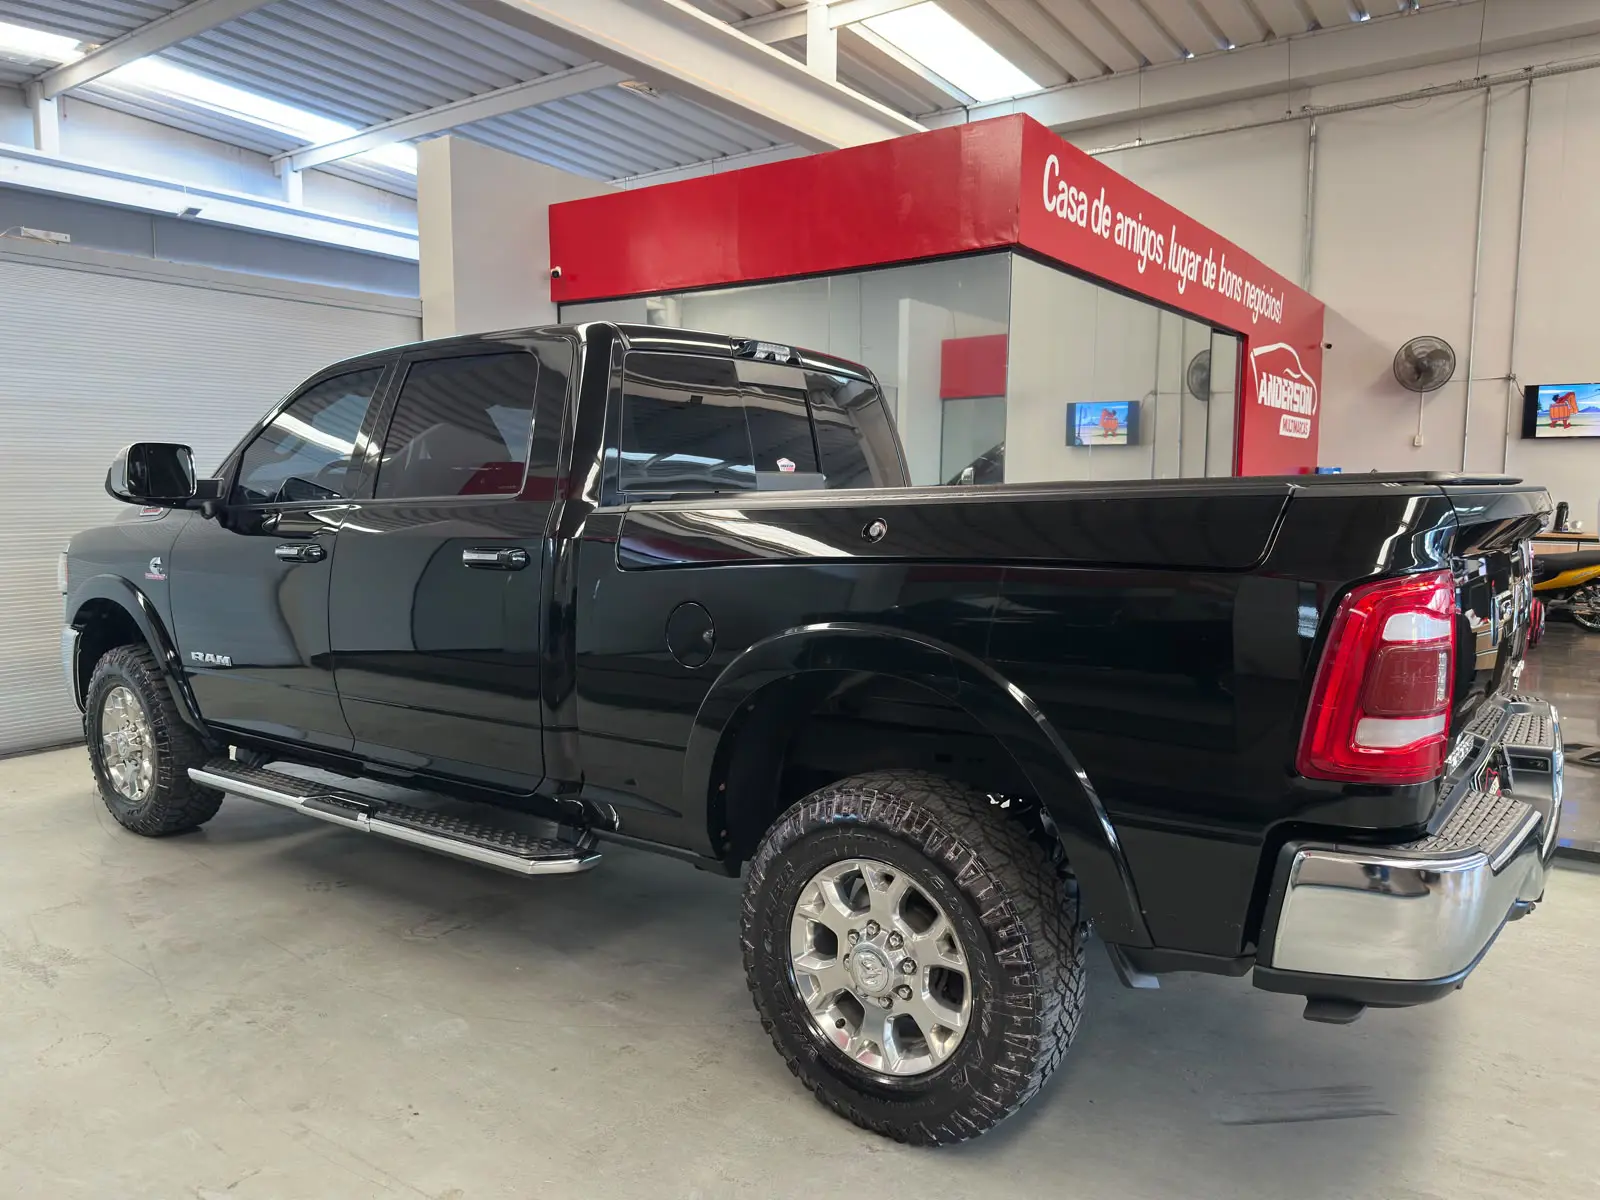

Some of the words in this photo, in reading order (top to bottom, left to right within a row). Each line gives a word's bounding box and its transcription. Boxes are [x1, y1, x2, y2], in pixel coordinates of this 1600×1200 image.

[1043, 154, 1088, 228] Casa
[1091, 187, 1111, 239] de
[1114, 212, 1166, 274] amigos,
[1168, 225, 1202, 294] lugar
[1202, 247, 1217, 290] de
[1218, 253, 1243, 302] bons
[1243, 280, 1284, 324] negócios!
[1258, 371, 1313, 416] ANDERSON
[190, 651, 232, 667] RAM
